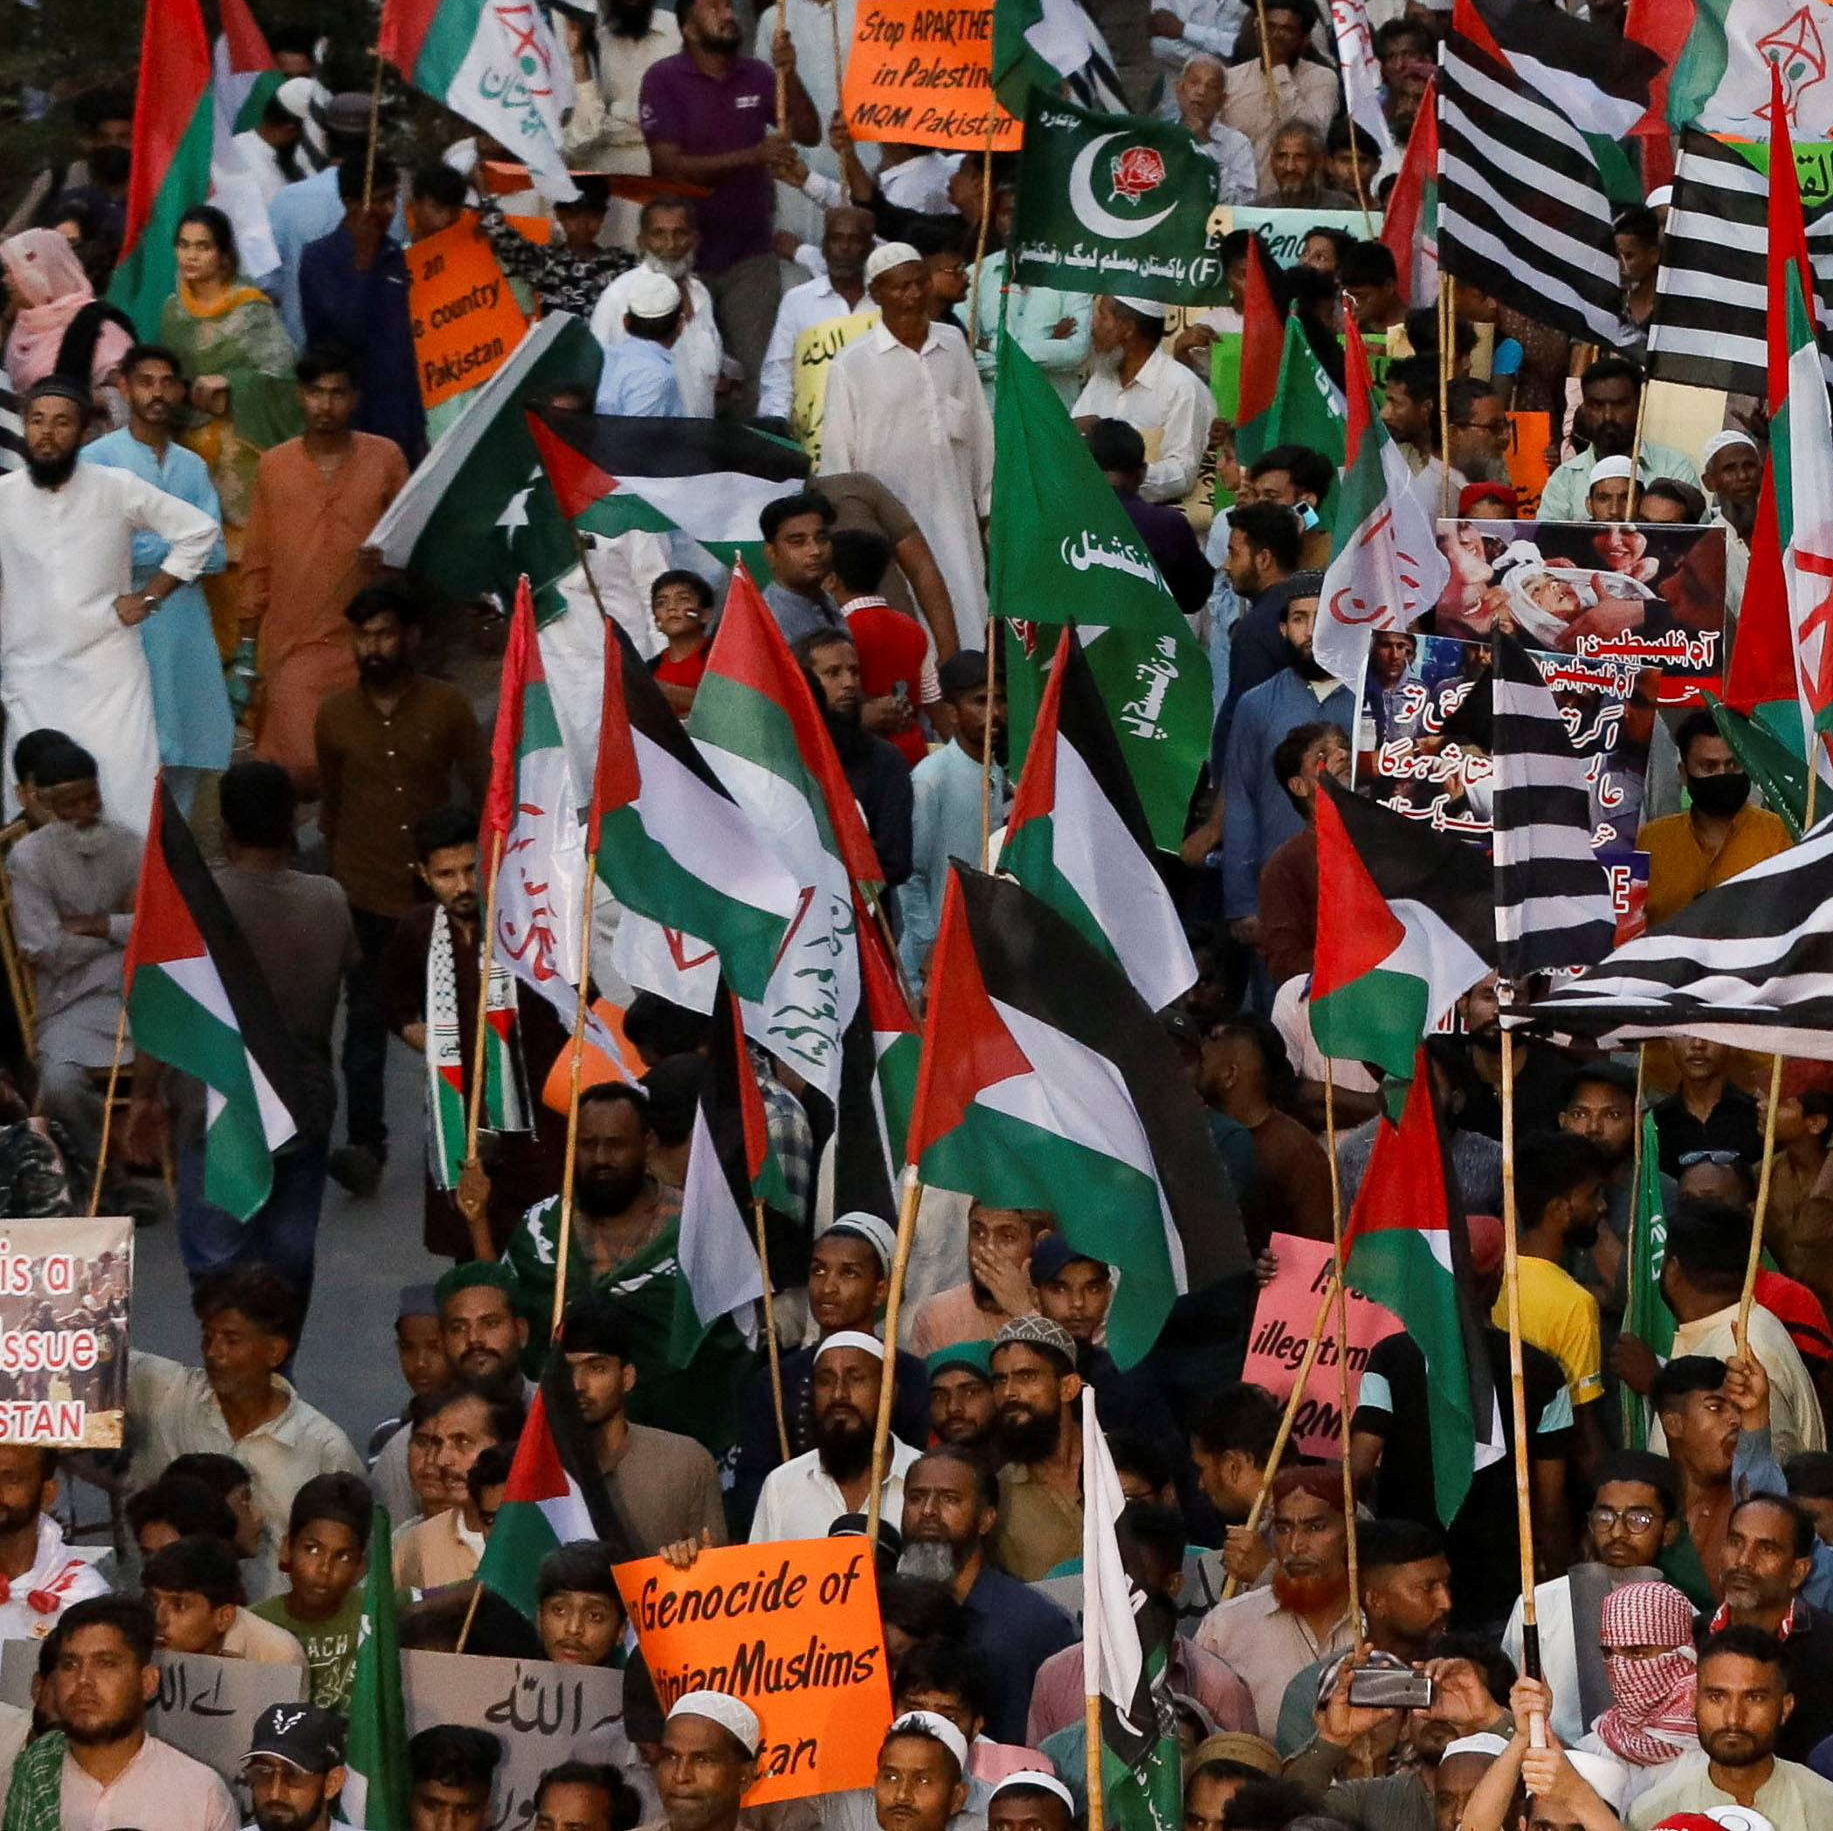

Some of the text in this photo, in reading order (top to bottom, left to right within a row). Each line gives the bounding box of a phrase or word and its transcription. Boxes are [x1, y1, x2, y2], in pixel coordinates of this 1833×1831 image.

[856, 9, 906, 50] Stop
[871, 61, 897, 88] in
[851, 102, 1012, 138] MQM Pakistan
[430, 277, 501, 330] country
[424, 337, 505, 392] Pakistan
[43, 1254, 75, 1298] a
[641, 1553, 865, 1634] Genocide of
[728, 1634, 880, 1698] Muslims
